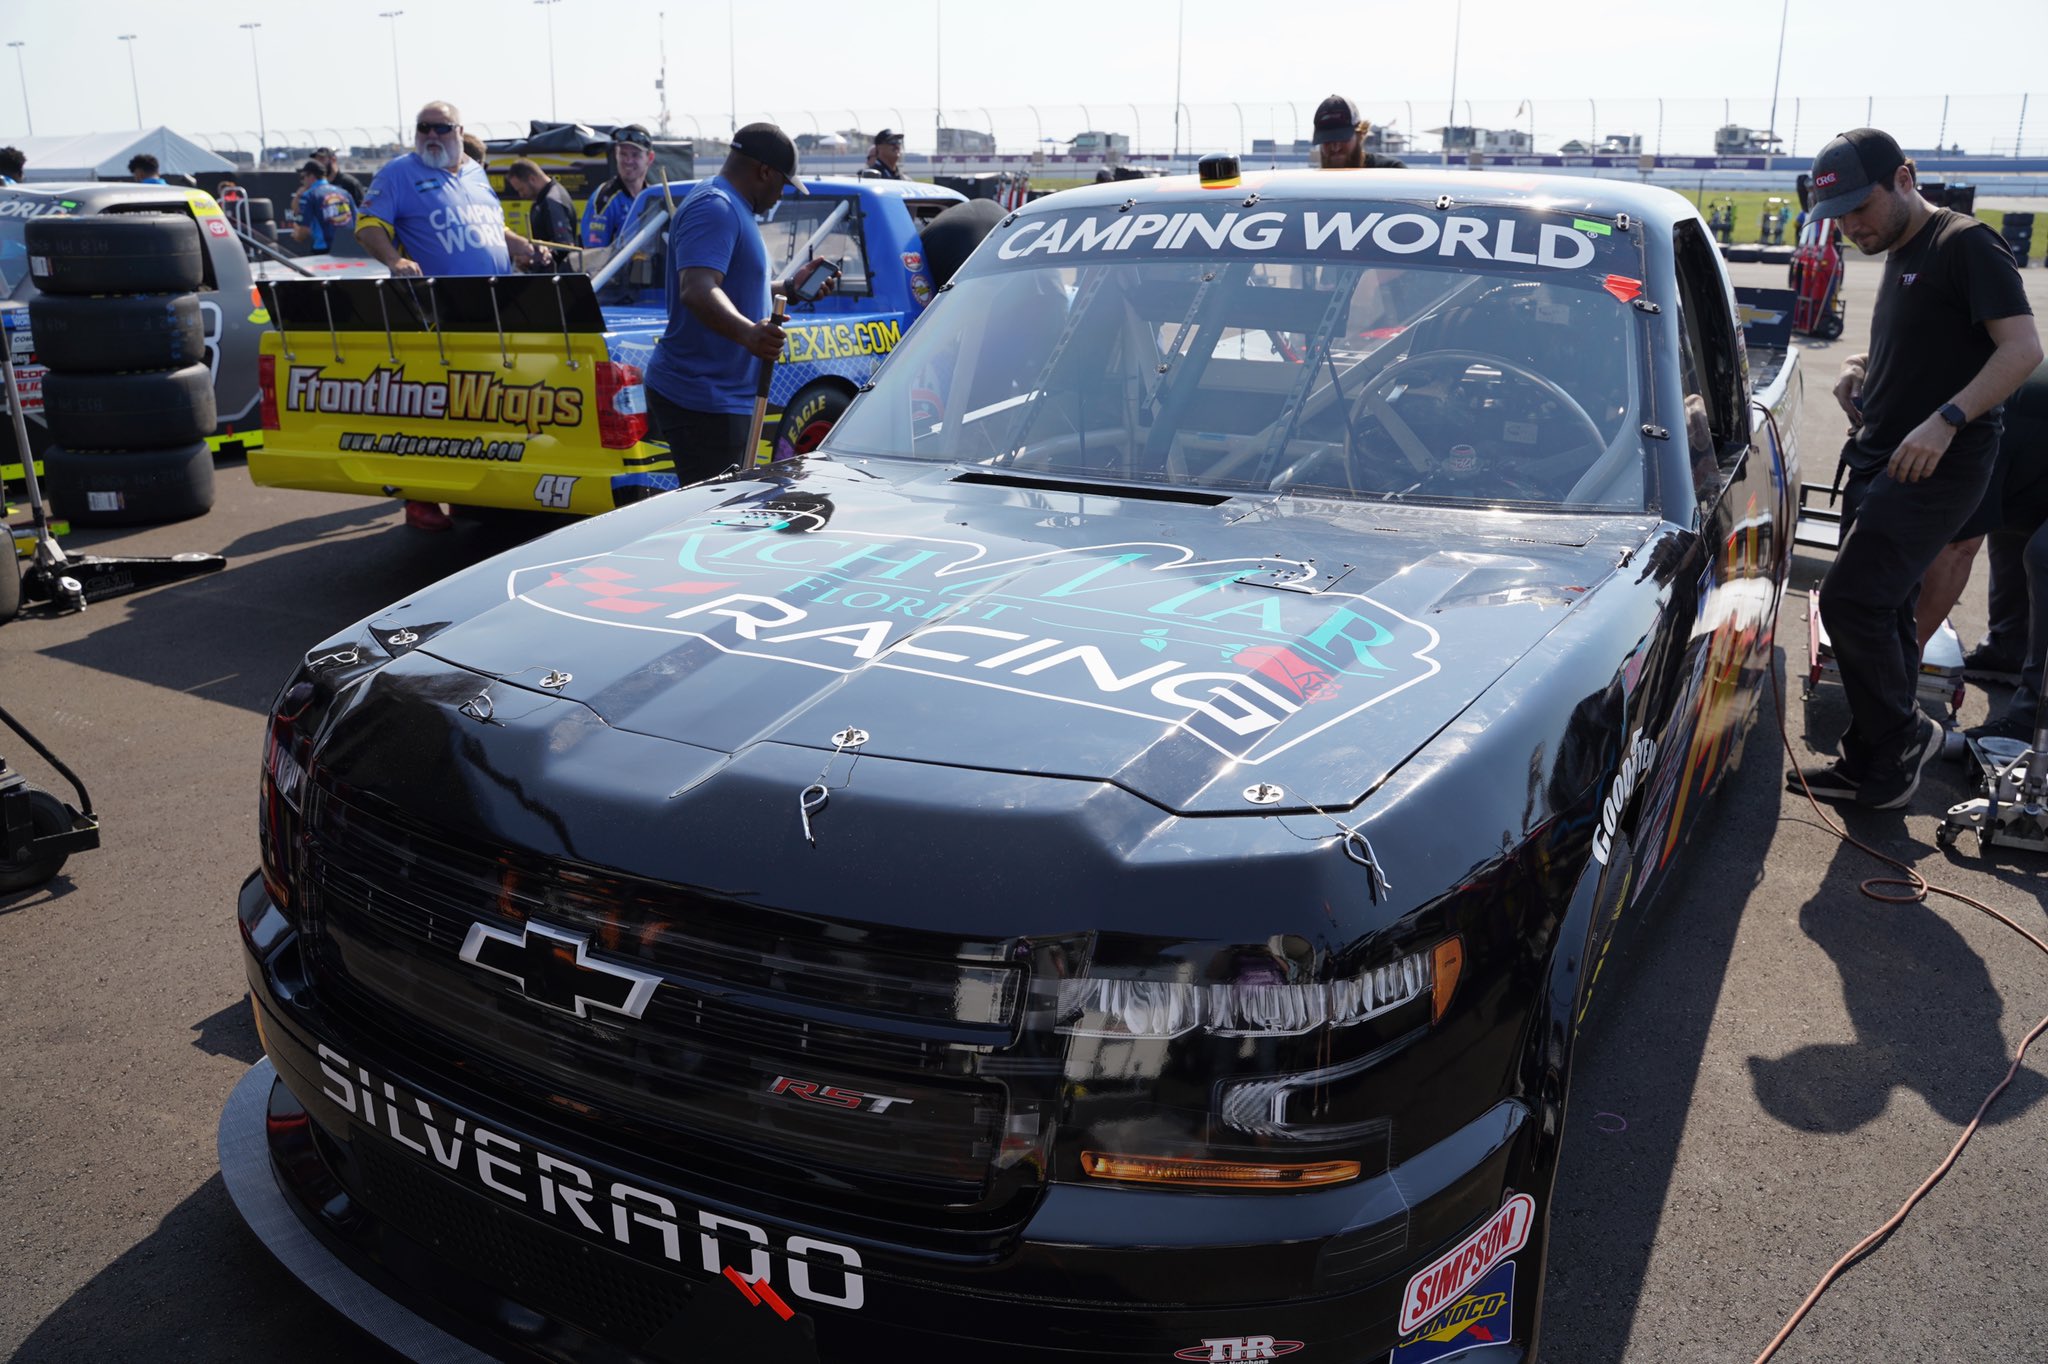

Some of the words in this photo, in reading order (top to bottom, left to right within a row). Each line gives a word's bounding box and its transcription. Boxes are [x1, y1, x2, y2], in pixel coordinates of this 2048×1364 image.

[435, 221, 507, 254] WORL
[998, 210, 1287, 260] CAMPING
[1303, 212, 1596, 269] WORLD
[779, 320, 901, 364] EXAS.COM
[788, 395, 826, 443] EAGLE
[534, 475, 579, 509] 49
[782, 576, 1024, 621] FLORIST
[666, 593, 1302, 735] RACING
[767, 1075, 914, 1114] RST
[317, 1043, 865, 1310] SILVERADO
[1411, 1207, 1516, 1320] SIMPSON
[1405, 1294, 1502, 1342] UNOCO
[1202, 1335, 1277, 1361] THR
